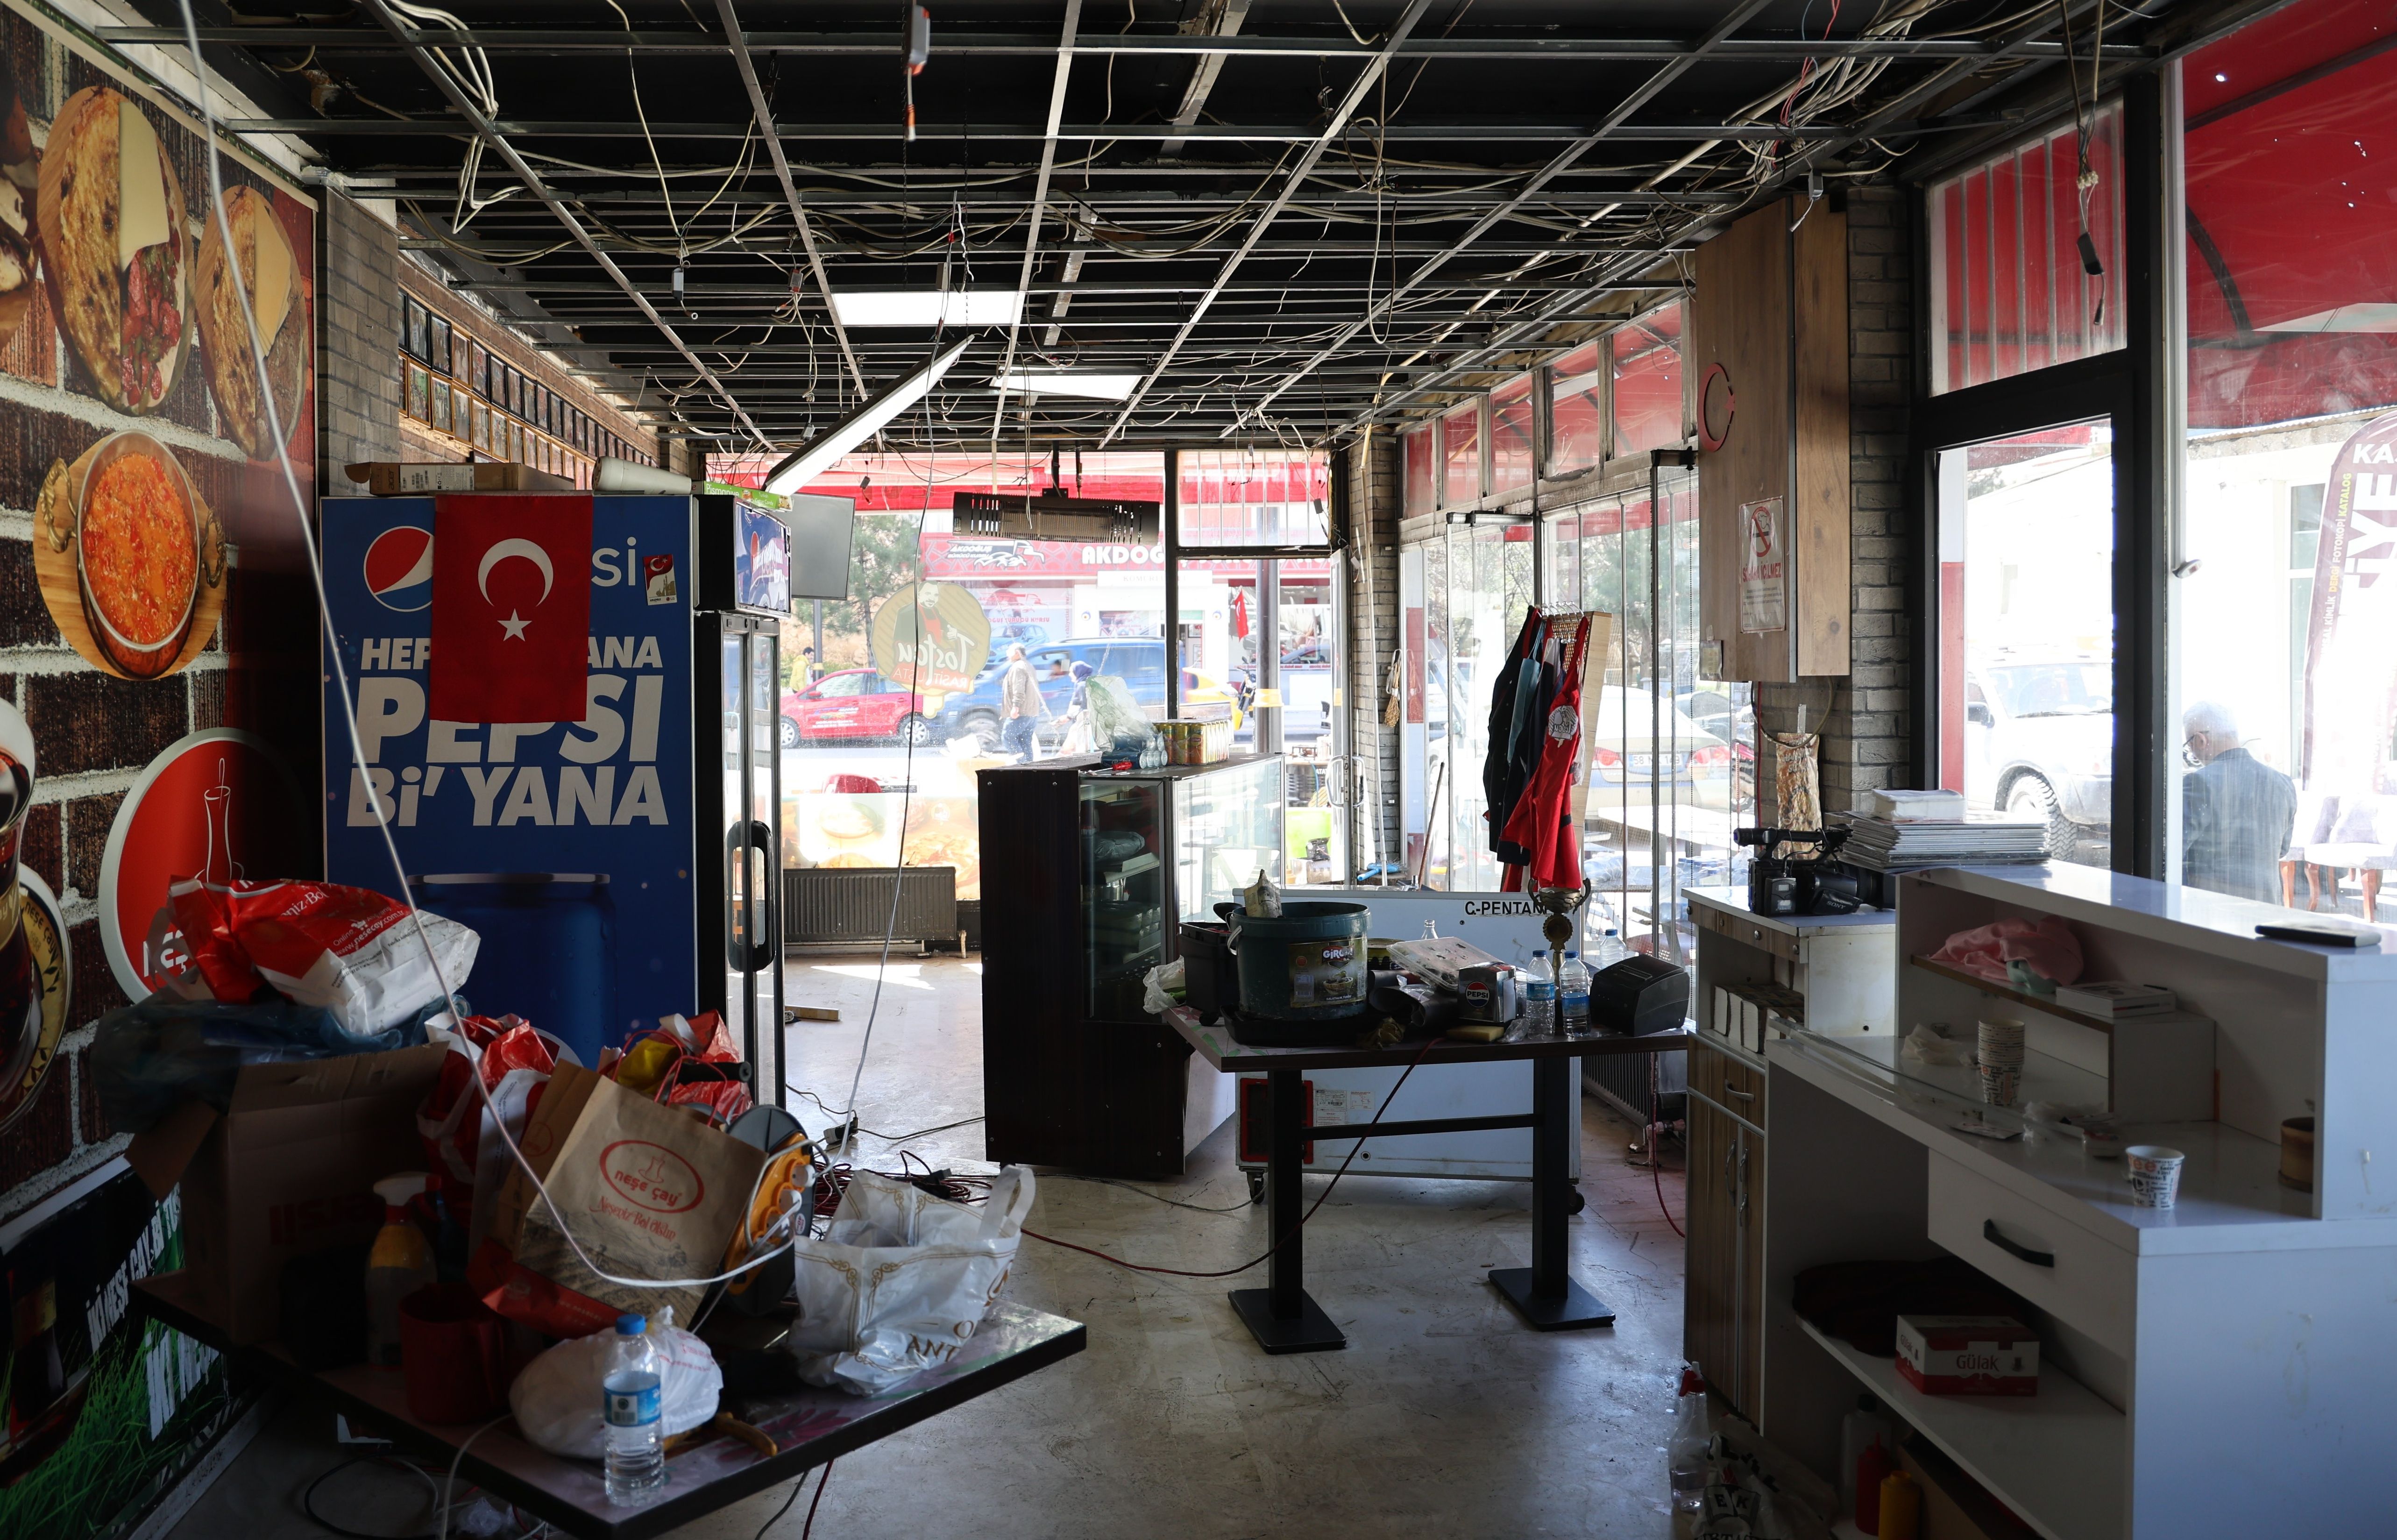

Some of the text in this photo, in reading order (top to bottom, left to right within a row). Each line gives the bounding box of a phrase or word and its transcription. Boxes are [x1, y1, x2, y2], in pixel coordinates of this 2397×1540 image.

[2353, 443, 2397, 464] KA
[2339, 472, 2352, 517] KATALOG
[2332, 518, 2346, 563] FOTOKOPİ
[2328, 566, 2340, 593] DERGİ
[2324, 595, 2336, 625] KİMLİK
[461, 766, 668, 825] YANA
[304, 885, 330, 904] Bol
[1826, 900, 1846, 909] SONY
[333, 929, 354, 946] Online
[614, 1170, 679, 1207] neşe çay
[633, 1212, 651, 1229] Bol
[1956, 1354, 1999, 1372] Gülak
